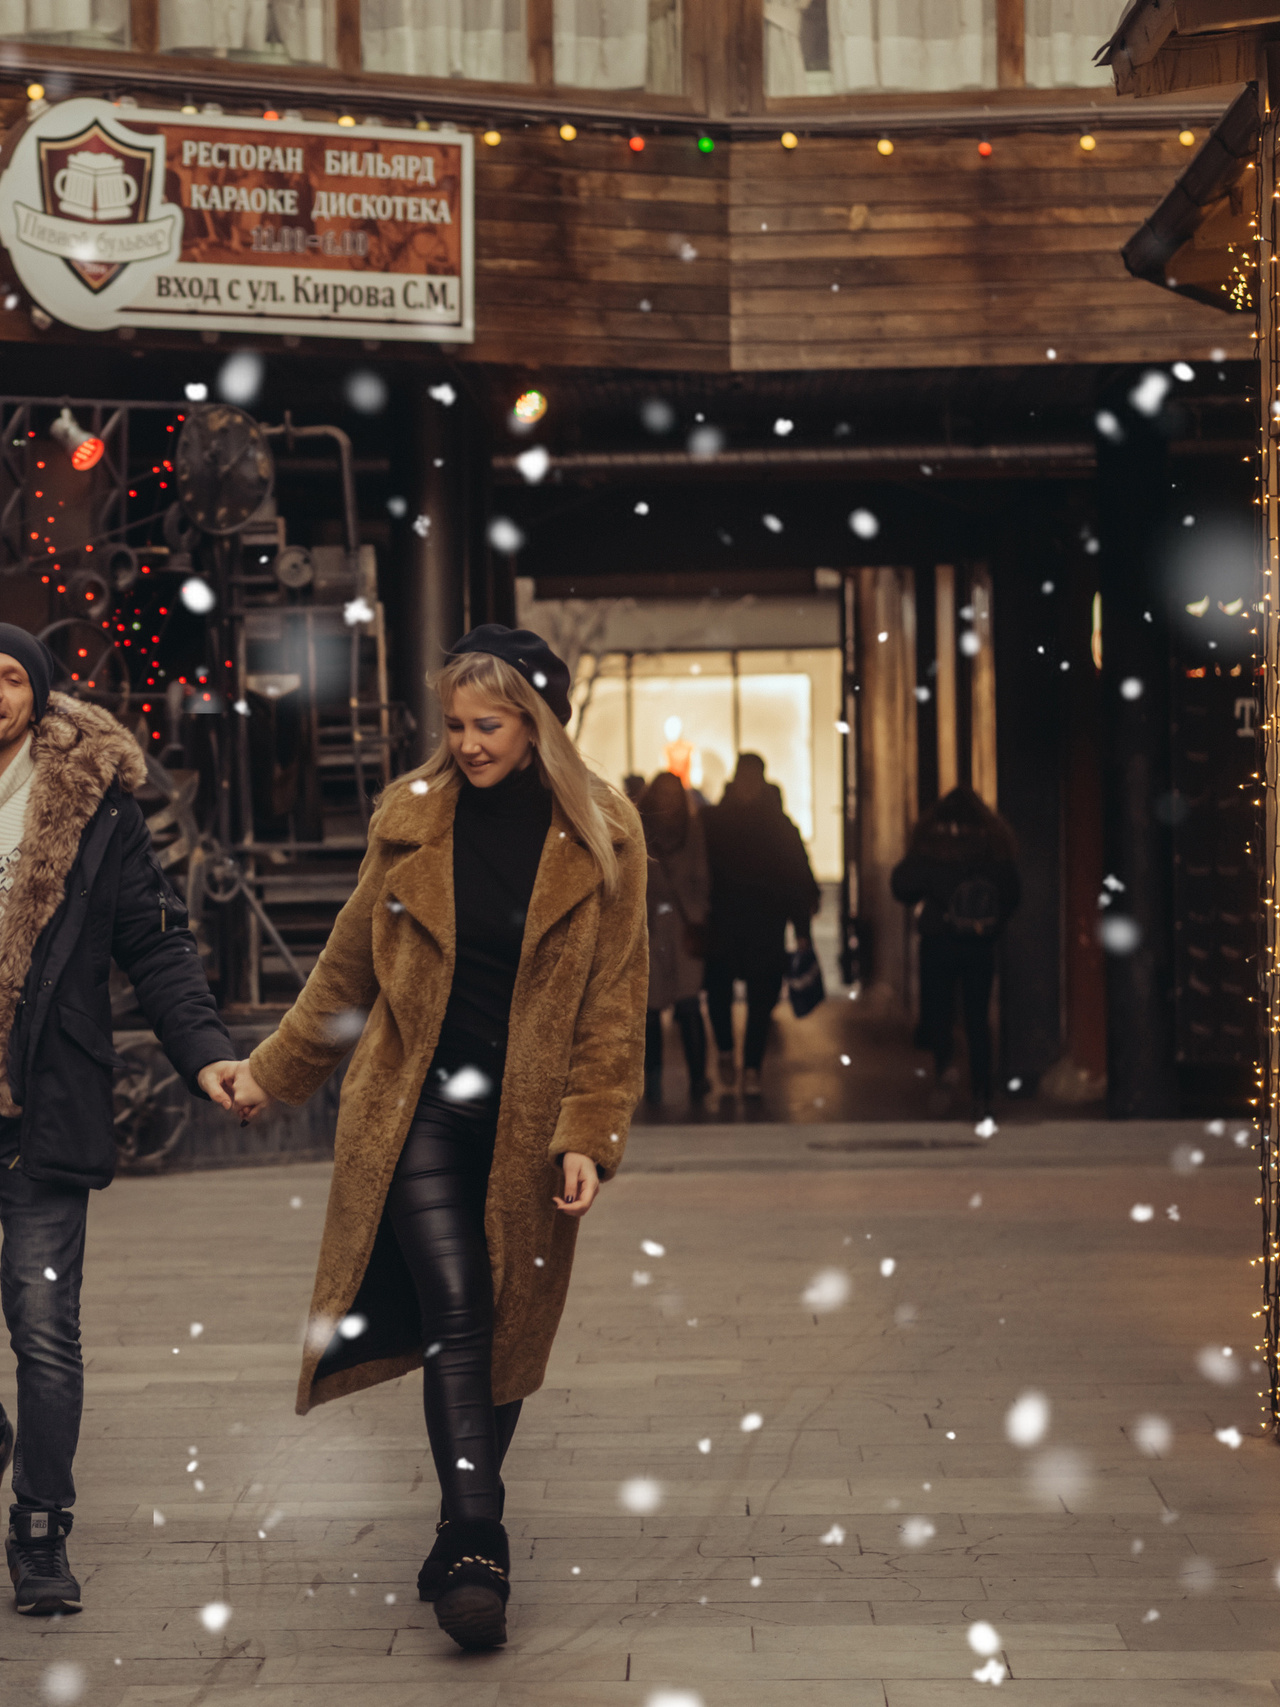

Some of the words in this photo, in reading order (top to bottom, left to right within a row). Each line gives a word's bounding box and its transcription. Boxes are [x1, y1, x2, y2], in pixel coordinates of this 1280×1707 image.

[182, 140, 304, 173] РЕСТОРАН
[325, 150, 436, 187] БИЛЬЯРД
[190, 184, 299, 216] КАРАОКЕ
[311, 191, 452, 224] ДИСКОТЕКА
[156, 275, 220, 305] вход
[227, 278, 241, 299] с
[247, 278, 285, 309] ул.
[292, 274, 395, 313] Кирова
[403, 280, 456, 311] С.М.
